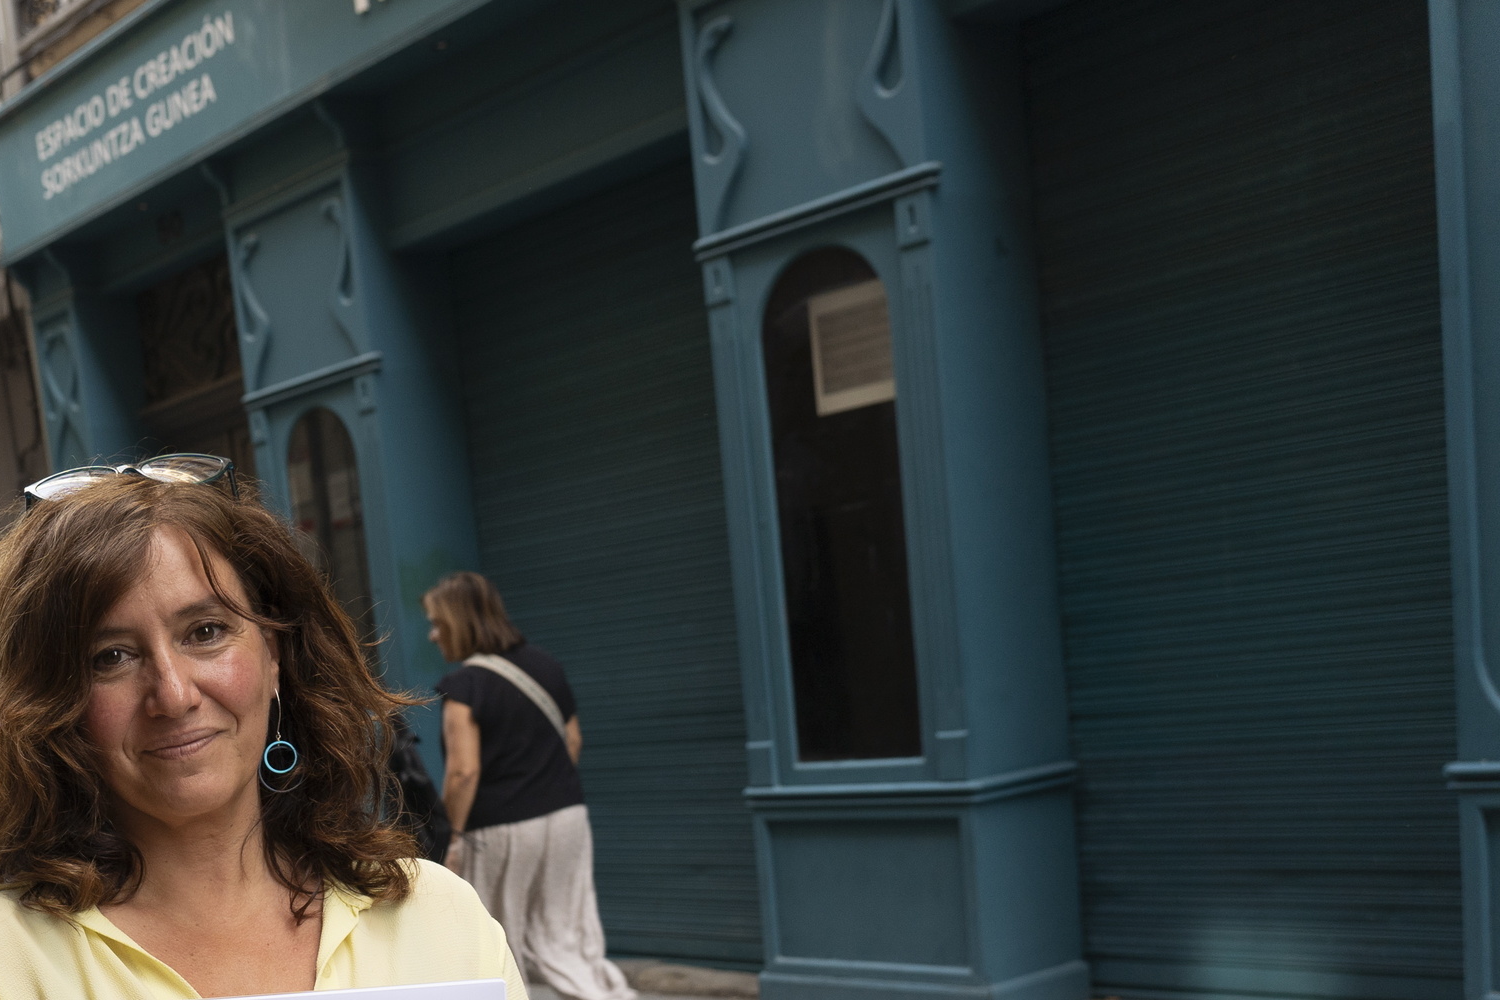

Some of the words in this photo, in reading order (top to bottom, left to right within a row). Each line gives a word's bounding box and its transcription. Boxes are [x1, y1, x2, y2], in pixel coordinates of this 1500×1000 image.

[35, 95, 105, 161] ESPACIO
[106, 76, 133, 117] DE
[133, 11, 234, 99] CREACIÓN
[41, 117, 145, 200] SORKUNTZA
[145, 74, 217, 138] GUNEA
